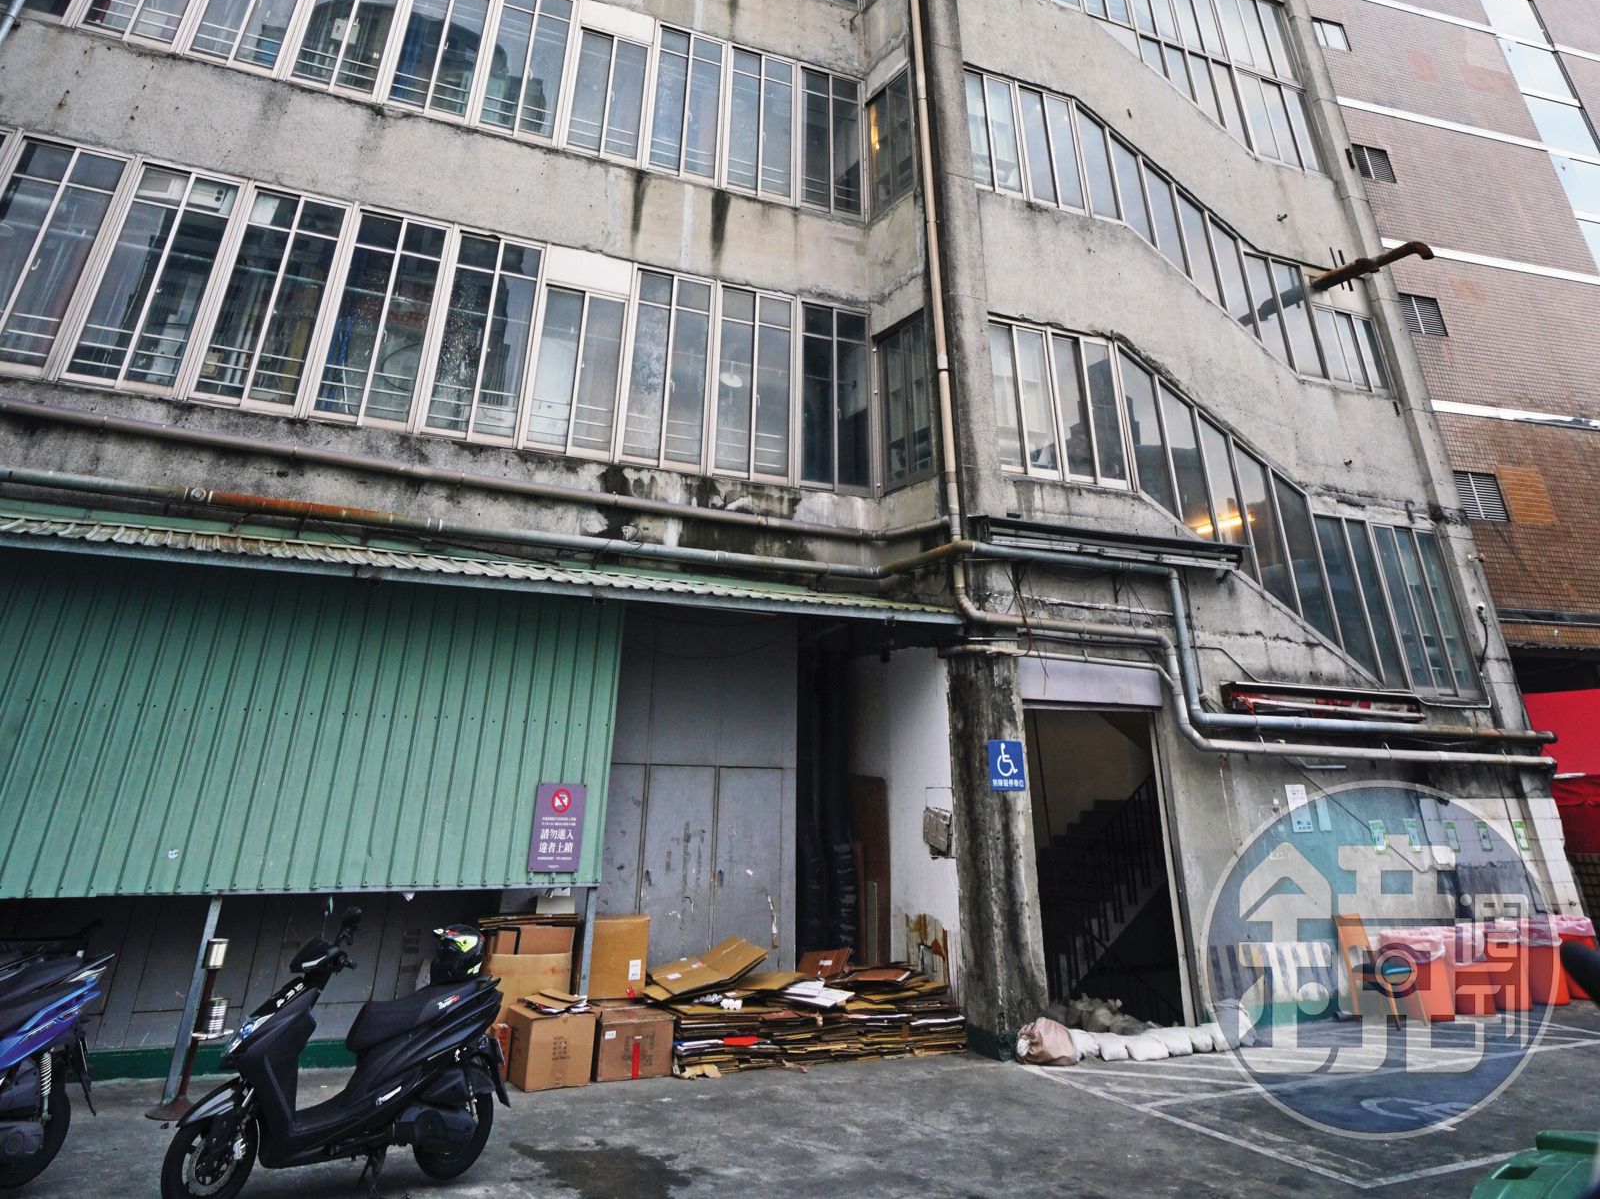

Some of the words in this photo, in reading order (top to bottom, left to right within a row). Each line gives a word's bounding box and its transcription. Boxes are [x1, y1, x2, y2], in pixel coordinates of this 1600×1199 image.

[539, 828, 574, 840] 請勿進入
[538, 842, 573, 853] 違者上鎖
